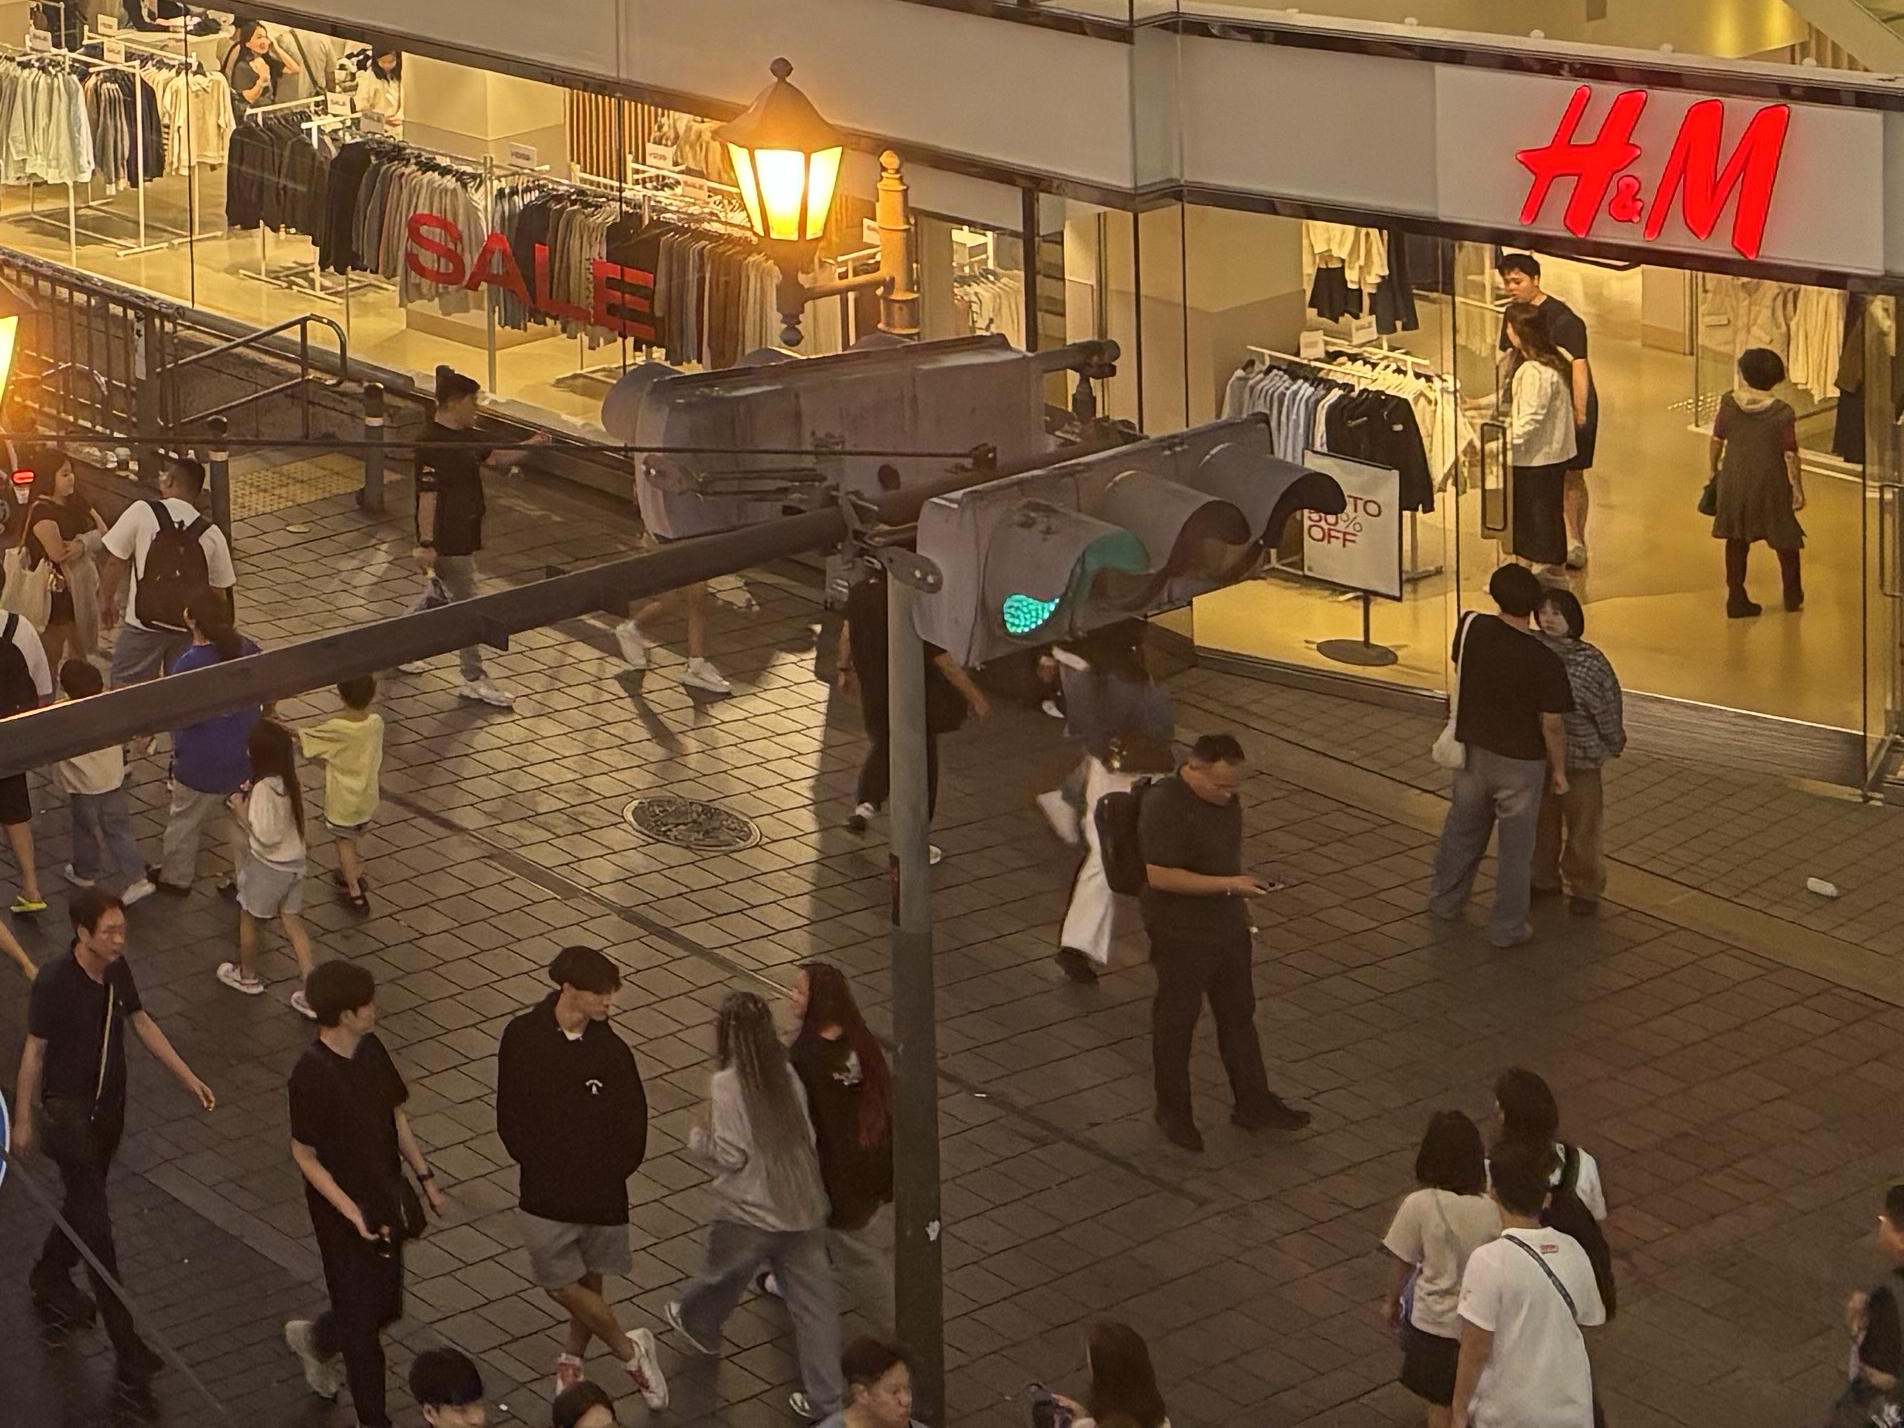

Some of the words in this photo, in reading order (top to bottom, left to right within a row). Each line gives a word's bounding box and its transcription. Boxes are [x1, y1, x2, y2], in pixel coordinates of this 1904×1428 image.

[1513, 83, 1791, 262] H&M
[406, 212, 657, 341] SALE
[1307, 524, 1359, 549] OFF
[1346, 494, 1383, 518] TO
